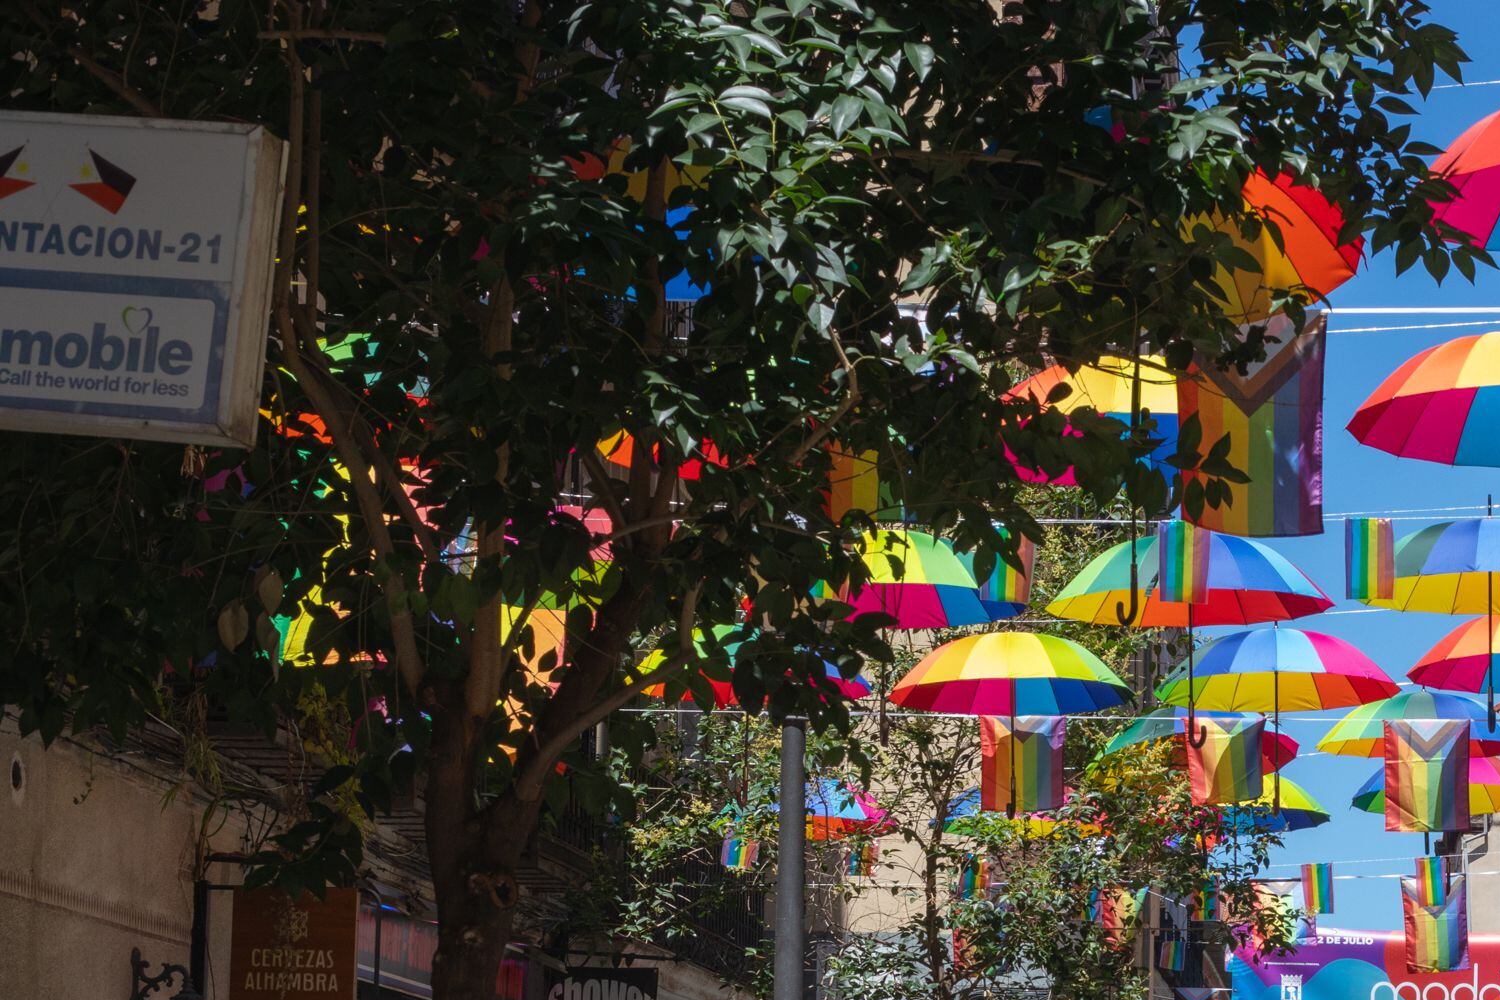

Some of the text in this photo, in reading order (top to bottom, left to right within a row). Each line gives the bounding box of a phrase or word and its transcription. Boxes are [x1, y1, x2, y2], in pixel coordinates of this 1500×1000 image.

[0, 321, 193, 376] mobile
[0, 368, 189, 397] Call the world for less
[1326, 936, 1341, 945] DE
[1343, 936, 1374, 946] JULIO
[250, 947, 335, 969] CERVEZAS
[243, 971, 339, 993] ALHAMBRA
